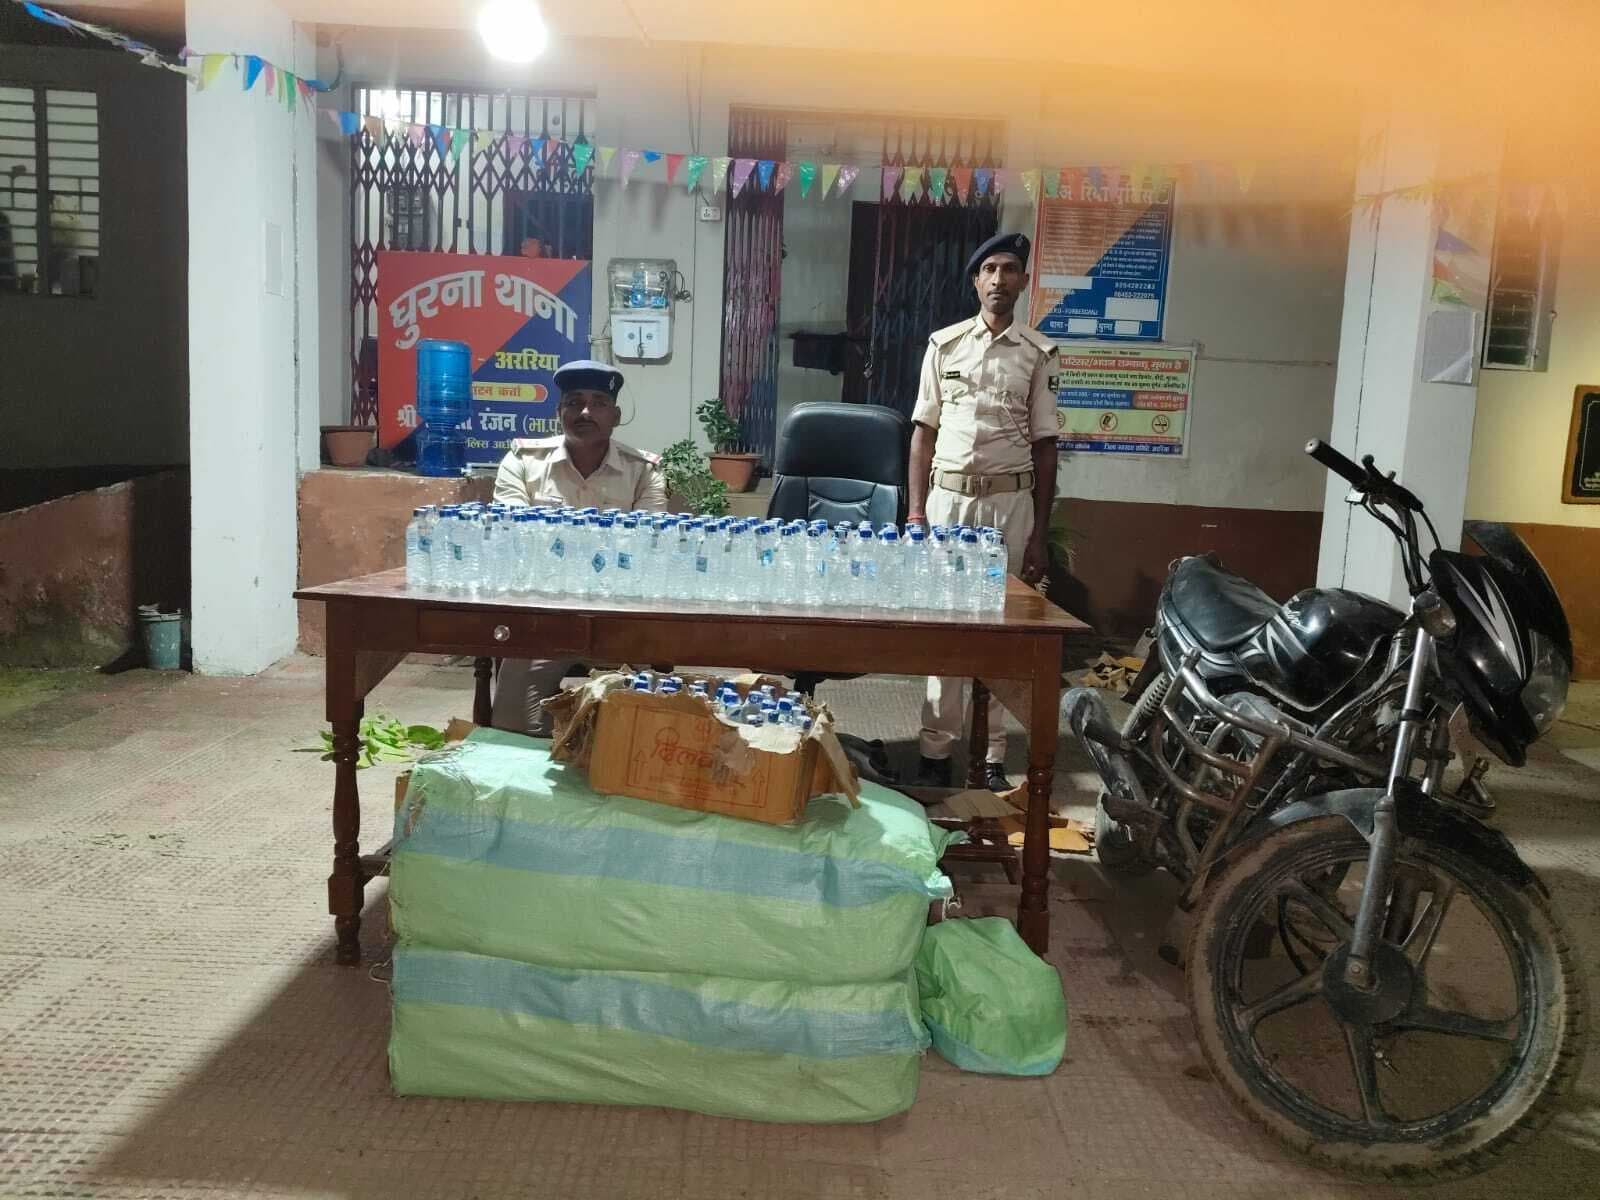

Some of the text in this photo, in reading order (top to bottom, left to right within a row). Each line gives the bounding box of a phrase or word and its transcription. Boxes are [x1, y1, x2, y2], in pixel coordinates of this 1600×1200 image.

[389, 270, 577, 349] घुरना थाना
[495, 348, 560, 371] अररिया
[397, 404, 417, 428] श्री
[478, 407, 517, 432] रंजन
